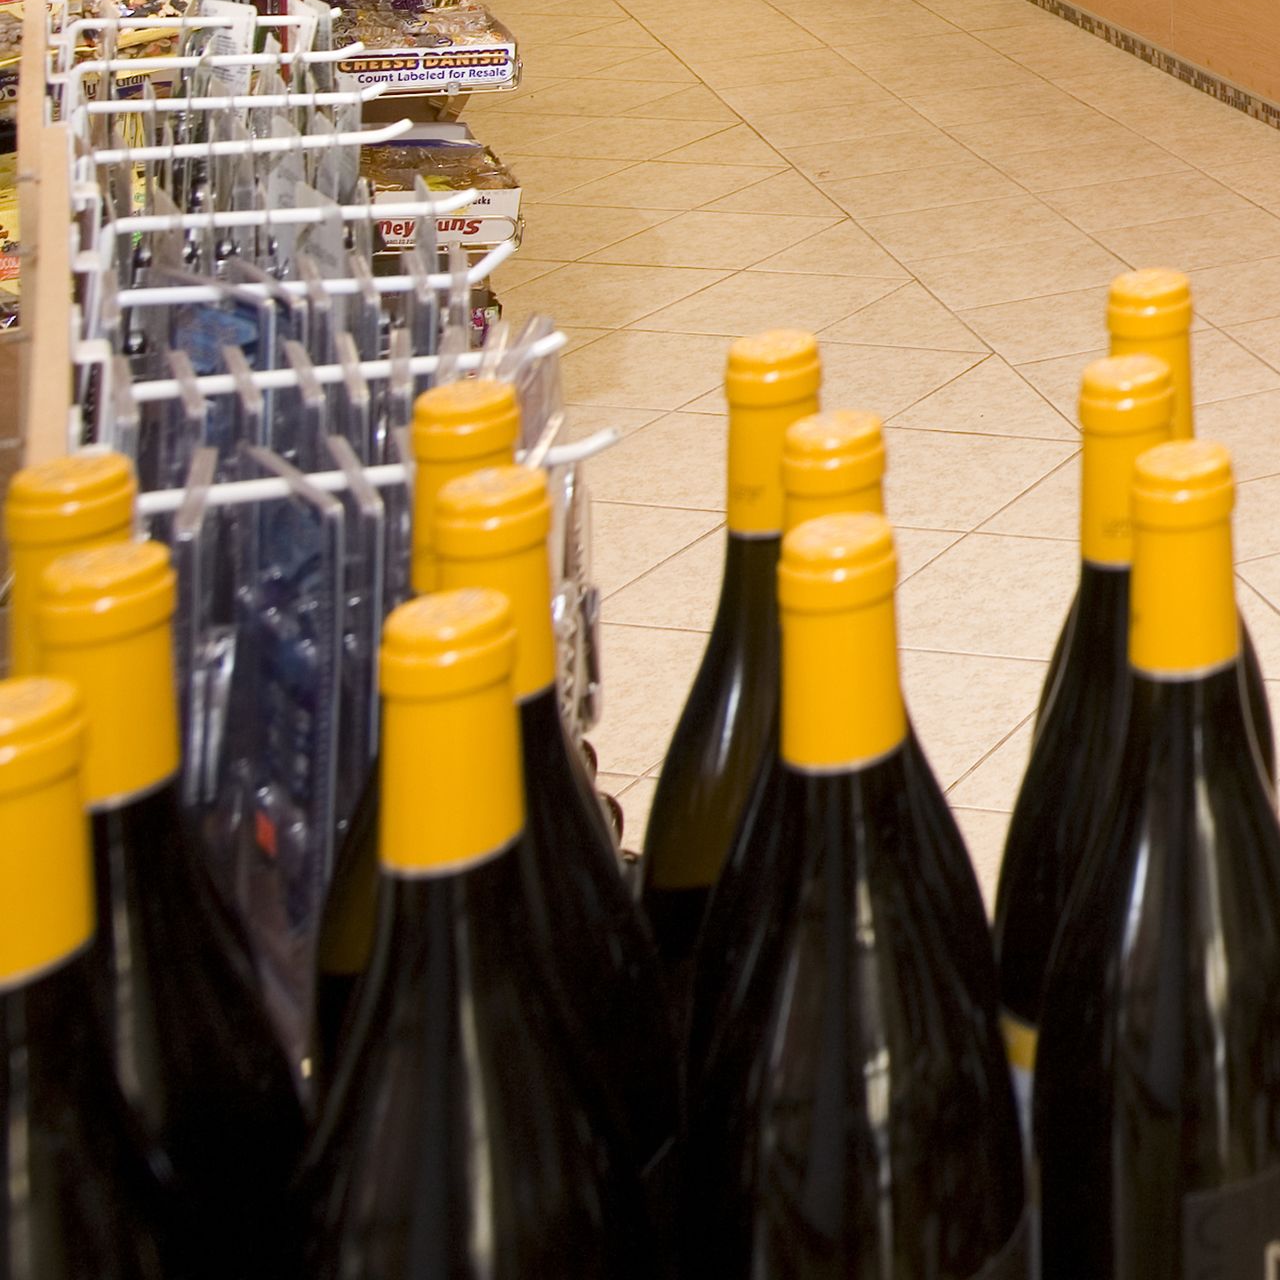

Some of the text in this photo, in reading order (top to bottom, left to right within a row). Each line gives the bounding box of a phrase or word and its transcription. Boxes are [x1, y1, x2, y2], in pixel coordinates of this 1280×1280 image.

[339, 49, 509, 73] CHEESE DANISH
[358, 68, 506, 83] Count Labeled for Resale
[381, 218, 482, 236] ney uns
